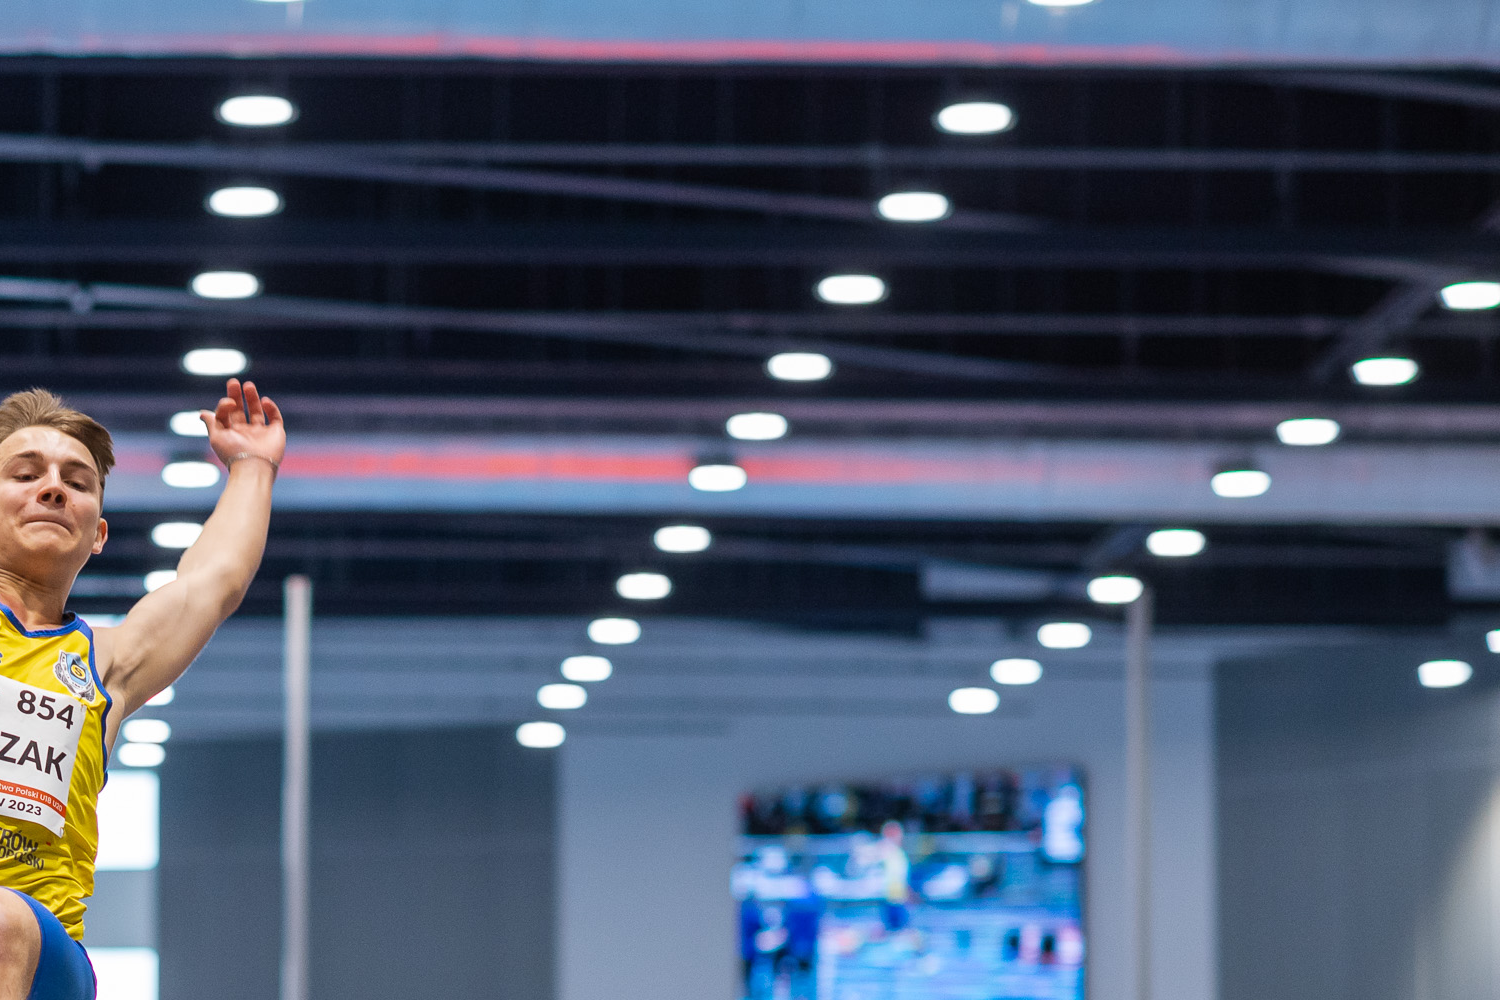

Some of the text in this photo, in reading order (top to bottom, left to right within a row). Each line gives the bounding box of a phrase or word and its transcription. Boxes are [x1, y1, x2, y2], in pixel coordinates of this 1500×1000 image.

[16, 689, 75, 730] 854
[7, 799, 42, 816] 2023
[15, 786, 39, 799] Polski
[40, 793, 52, 804] U18
[52, 799, 63, 812] U20
